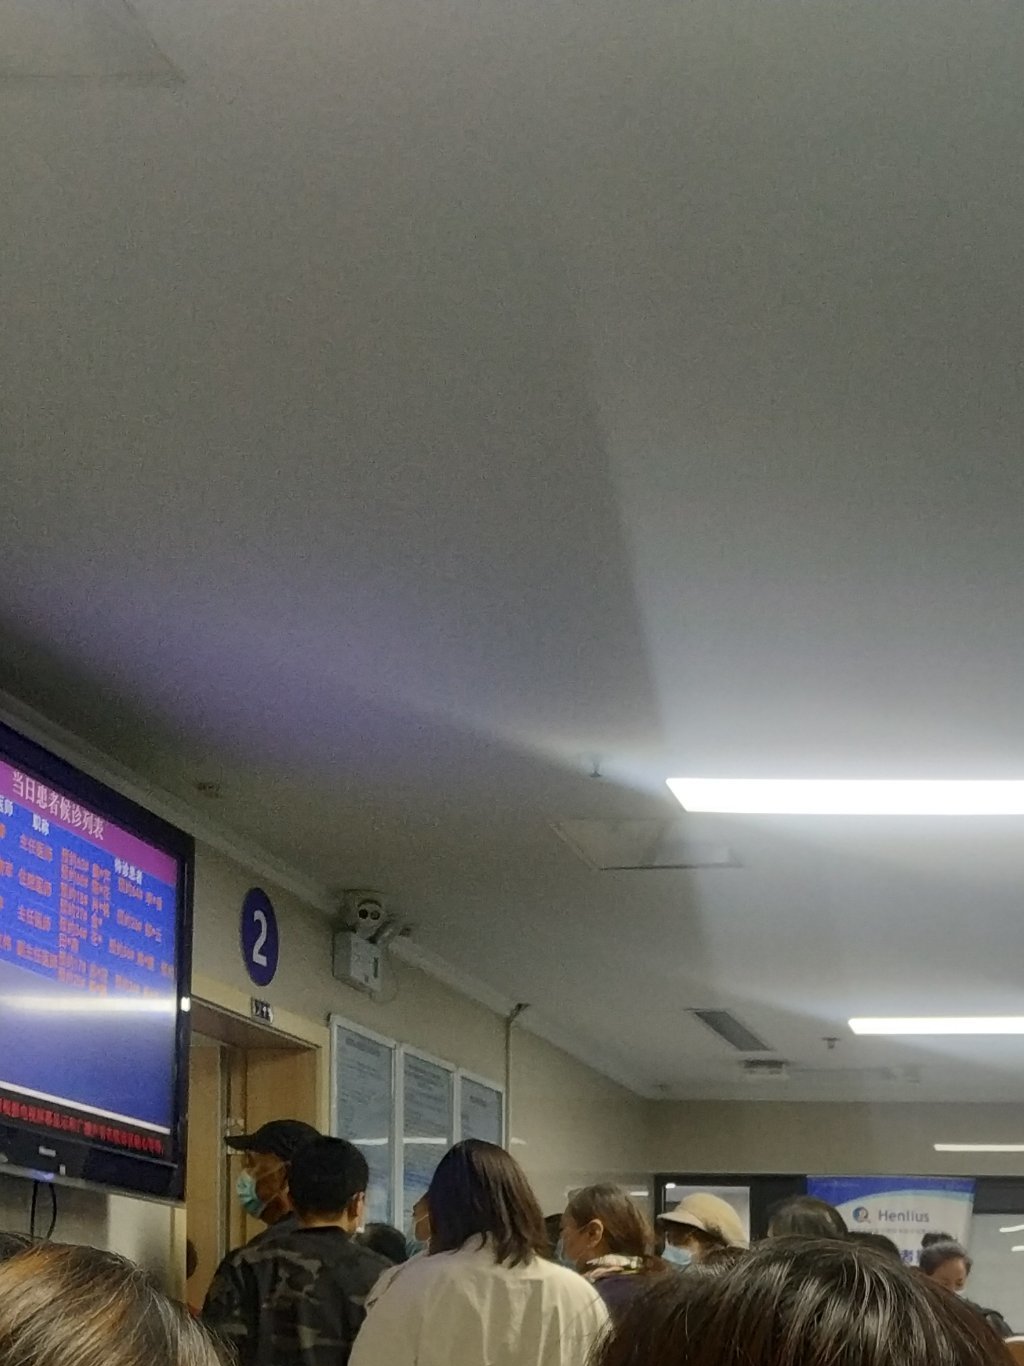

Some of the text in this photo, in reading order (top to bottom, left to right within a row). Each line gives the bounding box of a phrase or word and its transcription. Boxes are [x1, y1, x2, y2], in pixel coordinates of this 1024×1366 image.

[12, 769, 104, 841] 当日患者候诊列表
[252, 910, 268, 968] 2
[878, 1209, 930, 1223] Henlius
